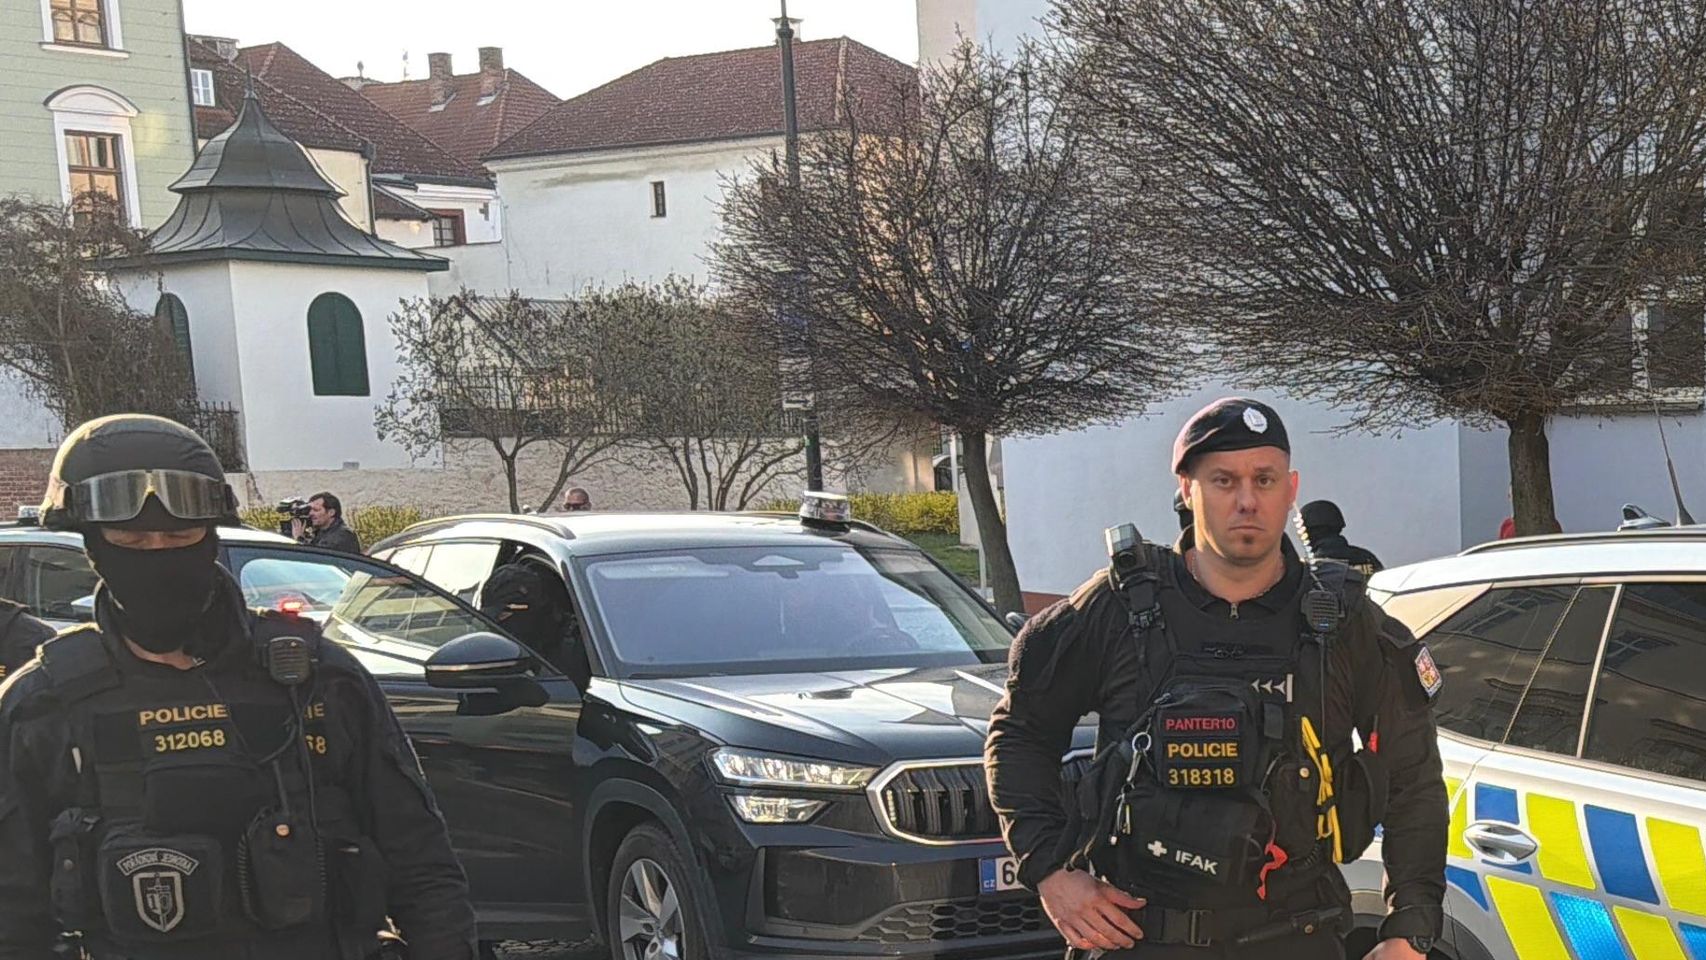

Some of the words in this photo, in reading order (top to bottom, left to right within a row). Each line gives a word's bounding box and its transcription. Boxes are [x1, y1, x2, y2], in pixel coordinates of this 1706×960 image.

[139, 704, 229, 726] POLICIE
[1166, 718, 1236, 731] PANTER10
[154, 729, 226, 752] 312068
[1167, 742, 1238, 758] POLICIE
[1168, 768, 1235, 786] 318318
[1174, 849, 1219, 875] IFAK
[983, 879, 995, 888] CZ
